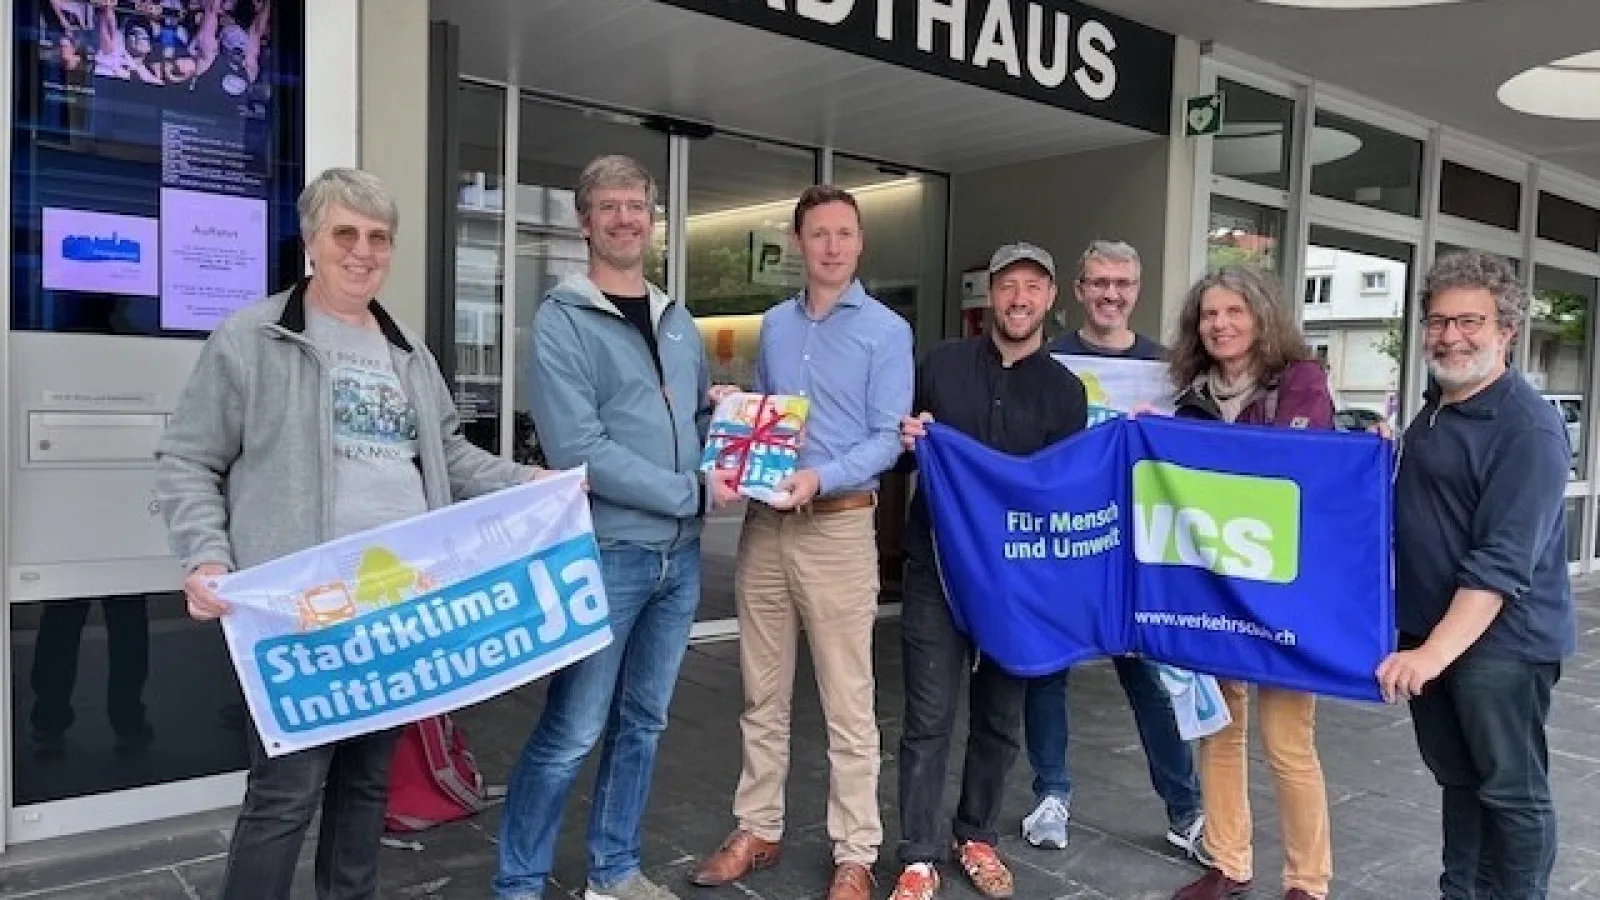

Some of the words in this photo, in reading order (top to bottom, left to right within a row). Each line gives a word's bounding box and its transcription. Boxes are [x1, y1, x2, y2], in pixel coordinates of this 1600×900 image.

[765, 0, 1117, 100] HAUS
[1004, 537, 1046, 558] und
[1007, 510, 1044, 533] Für
[264, 579, 518, 684] Stadtklima
[528, 555, 608, 643] Ja
[279, 625, 533, 727] Initiativen
